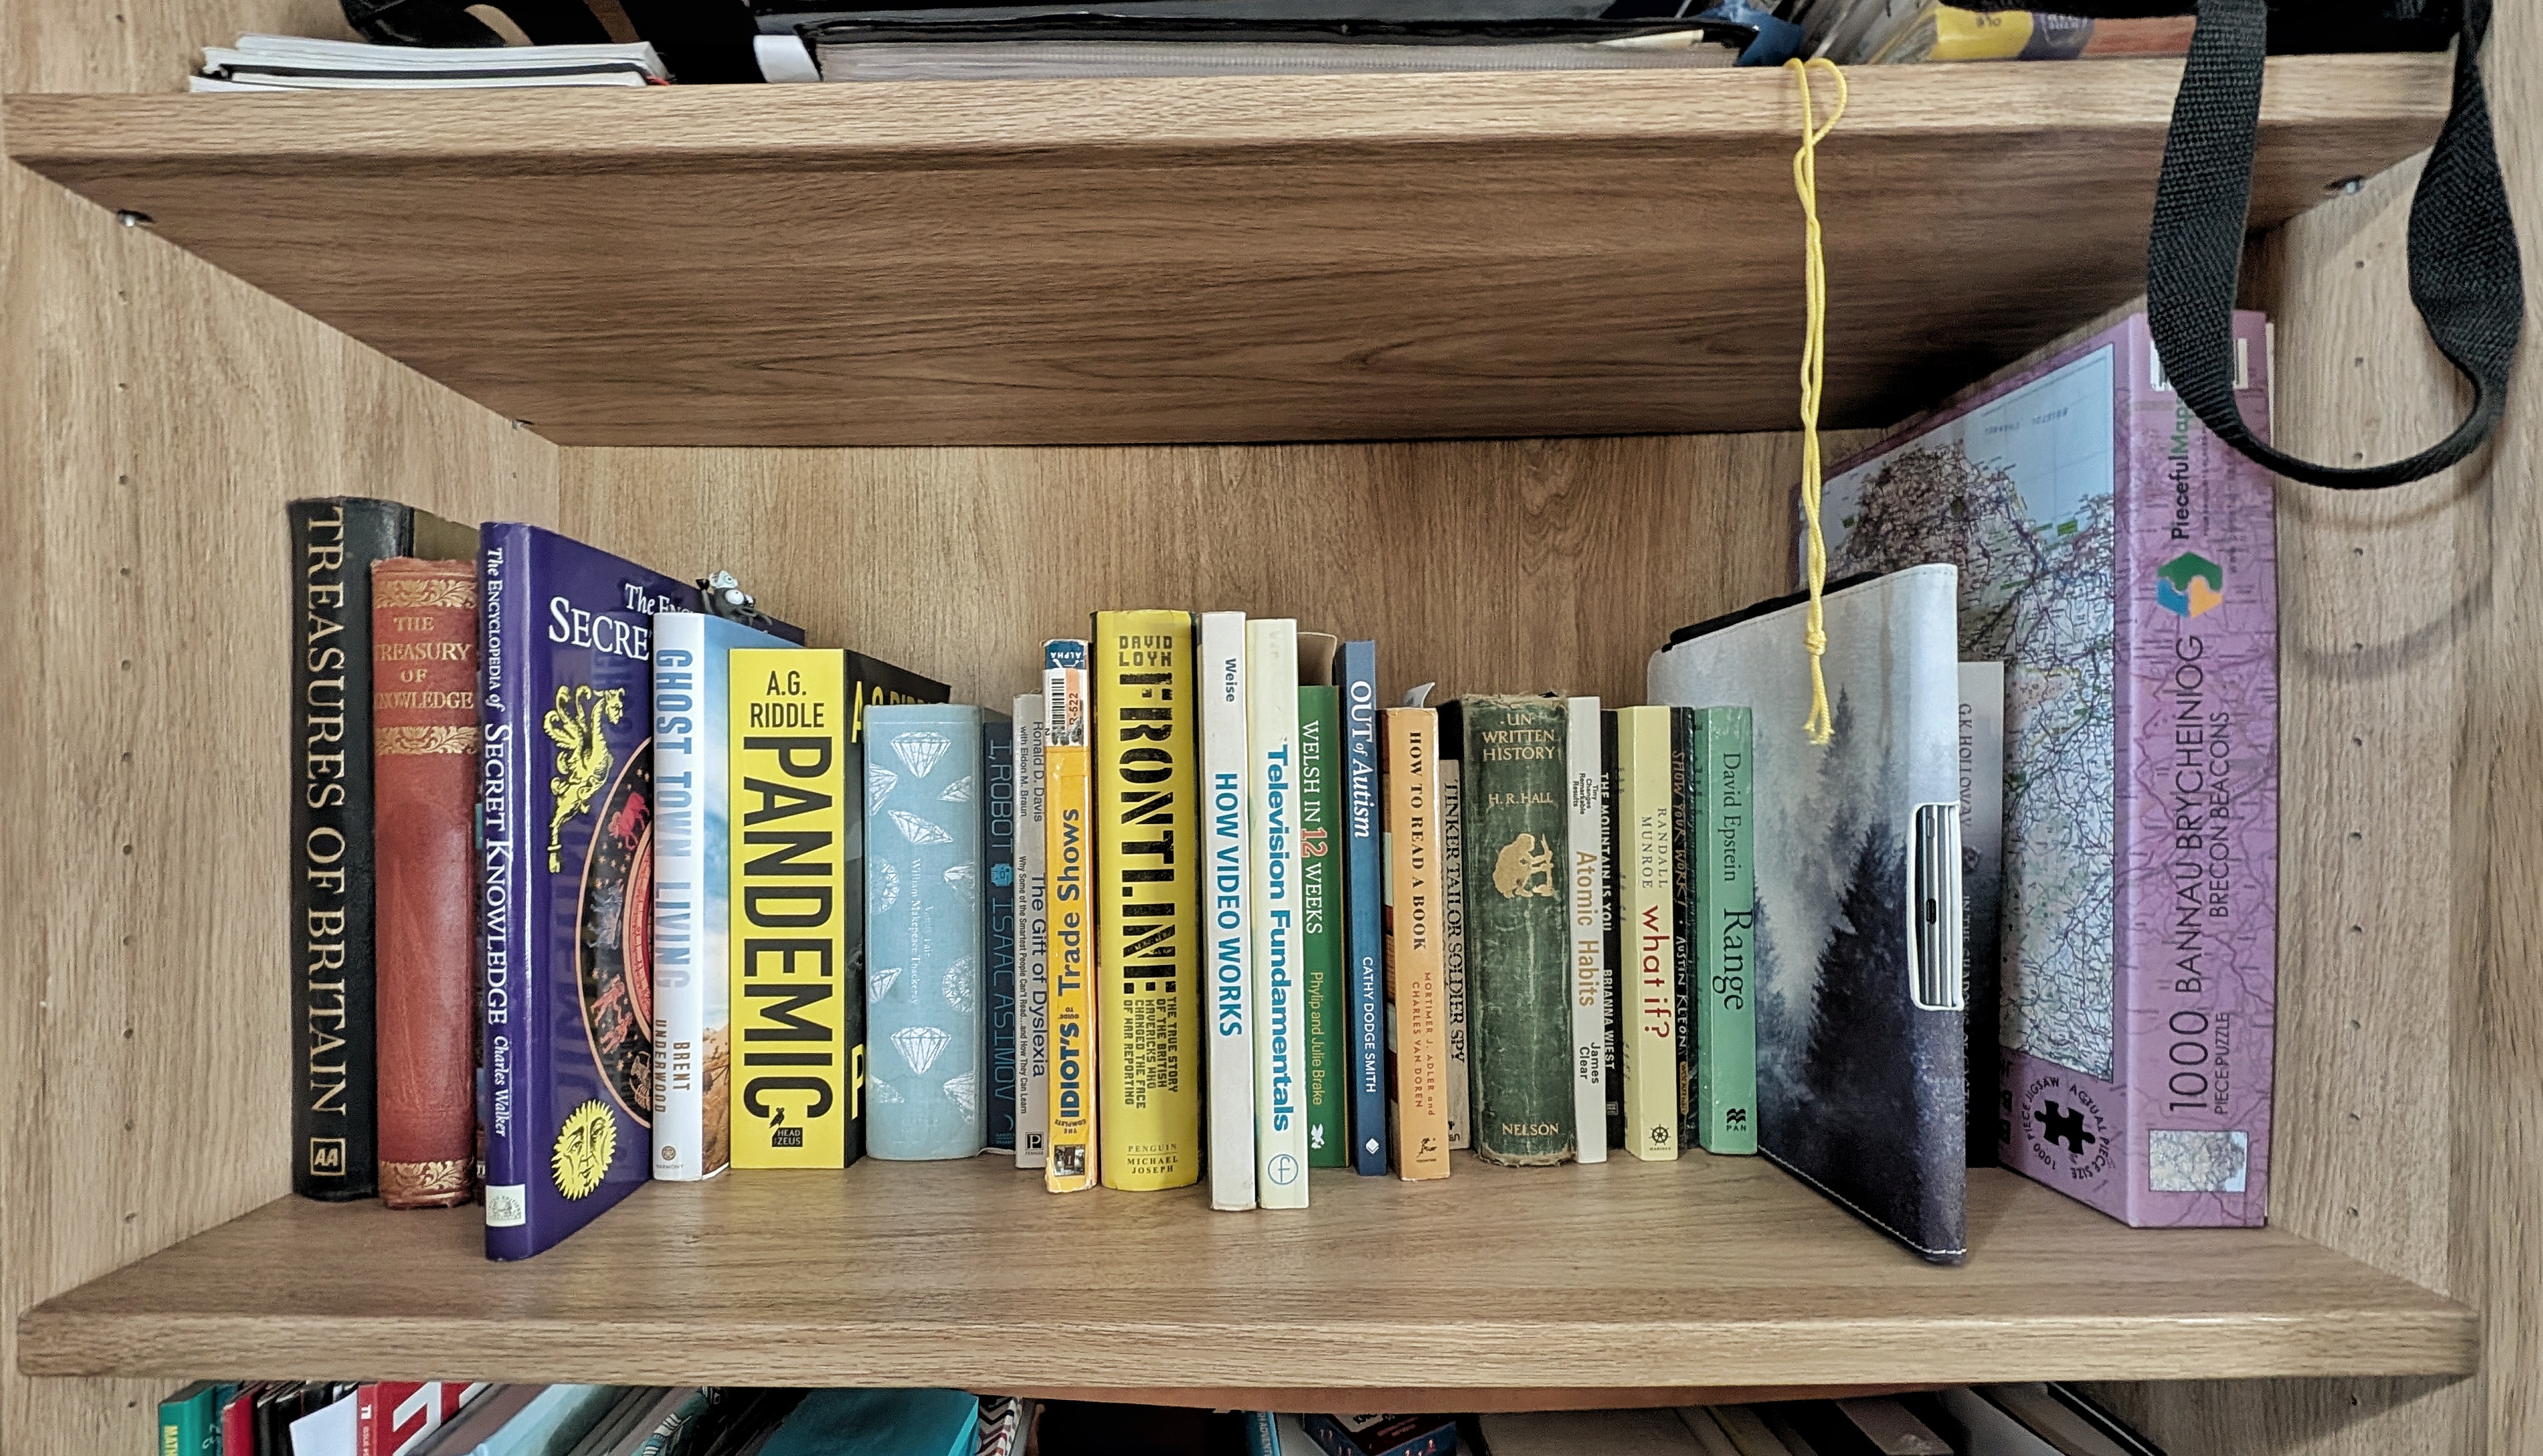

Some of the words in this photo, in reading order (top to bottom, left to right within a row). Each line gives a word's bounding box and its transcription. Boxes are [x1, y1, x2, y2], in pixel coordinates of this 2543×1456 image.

[487, 548, 503, 576] The
[625, 583, 655, 617] The
[392, 616, 434, 632] THE
[487, 580, 503, 690] ENCYCLOPEDIA
[1119, 635, 1172, 649] DAVID
[307, 506, 345, 809] TREASURES
[400, 669, 428, 682] OF
[1050, 651, 1082, 659] ALPHA
[1119, 651, 1172, 667] LOYN
[766, 670, 807, 696] A.G.
[1224, 657, 1237, 703] Weise
[486, 694, 506, 711] of
[655, 649, 693, 754] GHOST
[749, 703, 825, 728] RIDDLE
[1350, 681, 1373, 743] OUT
[1020, 726, 1028, 745] with
[1033, 721, 1044, 765] Ronald
[1352, 742, 1367, 757] of
[1409, 732, 1423, 777] HOW
[1482, 729, 1555, 744] WRITTEN
[1483, 746, 1556, 762] HISTORY
[2175, 634, 2204, 851] BRYCHEINIOG
[484, 724, 512, 831] SECRET
[1020, 747, 1029, 773] Eldon
[1034, 770, 1044, 783] D.
[1303, 720, 1320, 795] WELSH
[1672, 751, 1686, 799] SHOW
[2209, 711, 2229, 820] BEACONS
[1020, 776, 1028, 787] M.
[1353, 758, 1376, 838] Autism
[1410, 783, 1423, 809] TO
[1521, 792, 1553, 804] HALL
[1591, 785, 1599, 801] Tiny
[1601, 772, 1609, 799] THE
[1723, 753, 1742, 808] David
[655, 771, 693, 857] TOWN
[1020, 790, 1029, 817] Braun
[1034, 787, 1045, 822] Davis
[1214, 773, 1239, 839] HOW
[1267, 743, 1291, 900] Television
[1304, 800, 1321, 823] IN
[1445, 779, 1460, 861] TINKER
[1673, 801, 1686, 842] YOUR
[1119, 672, 1176, 994] FRONTLINE
[1301, 827, 1328, 858] 12
[1411, 817, 1424, 870] READ
[1601, 804, 1611, 877] MOUNTAIN
[1641, 816, 1653, 888] MUNROE
[1658, 807, 1668, 888] RANDALL
[1718, 815, 1742, 882] Epstein
[307, 827, 345, 892] OF
[1018, 856, 1026, 871] Why
[1057, 809, 1080, 901] Shows
[2209, 825, 2229, 918] BRECON
[1019, 873, 1027, 893] Some
[1032, 873, 1046, 911] The
[1216, 844, 1240, 930] VIDEO
[1305, 862, 1323, 935] WEEKS
[1412, 877, 1425, 889] A
[1576, 851, 1599, 926] Atomic
[1674, 849, 1688, 907] WORK!
[1447, 862, 1463, 937] TAILOR
[1602, 897, 1613, 931] YOU
[486, 833, 513, 1025] KNOWLEDGE
[653, 881, 691, 988] LIVING
[743, 736, 833, 1118] PANDEMIC
[992, 897, 1014, 986] ISAAC
[1019, 918, 1027, 951] Smartest
[1032, 919, 1047, 956] Gift
[1412, 895, 1426, 951] BOOK
[2175, 862, 2203, 994] BANNAU
[1018, 953, 1027, 977] People
[1058, 912, 1081, 997] Trade
[1642, 905, 1670, 988] what
[1676, 936, 1687, 986] AUSTIN
[1712, 908, 1754, 1011] Range
[1019, 978, 1028, 998] Can't
[1032, 964, 1047, 983] of
[1218, 936, 1242, 1038] WORKS
[1309, 972, 1324, 1009] Phylip
[1362, 956, 1373, 1000] CATHY
[1447, 941, 1464, 1025] SOLDIER
[1577, 940, 1599, 1007] Habits
[308, 907, 346, 1116] BRITAIN
[1124, 1000, 1134, 1016] OF
[1156, 999, 1166, 1014] OF
[1166, 997, 1177, 1018] THE
[1412, 982, 1421, 1035] CHARLES
[1425, 972, 1433, 1035] MORTIMER
[1603, 969, 1613, 1026] BRIANNA
[1644, 998, 1672, 1038] if?
[1029, 990, 1048, 1077] Dyslexia
[1124, 1018, 1134, 1040] WAR
[1135, 1000, 1146, 1050] CHANGED
[1145, 1000, 1156, 1063] MAVERICKS
[1157, 1018, 1167, 1041] THE
[1166, 1020, 1178, 1051] TRUE
[1270, 909, 1295, 1132] Fundamentals
[1310, 1012, 1324, 1034] and
[1363, 1003, 1375, 1050] DODGE
[1676, 994, 1688, 1048] KLEON
[2215, 1012, 2231, 1066] PUZZLE
[493, 1036, 509, 1086] Charles
[655, 1019, 667, 1113] UNDERWOOD
[673, 1042, 691, 1091] BRENT
[994, 993, 1016, 1100] ASIMOV
[1136, 1053, 1146, 1074] THE
[1157, 1043, 1168, 1088] BRITISH
[1311, 1036, 1325, 1068] Julie
[1413, 1039, 1422, 1062] VAN
[1451, 1029, 1465, 1064] SPY
[1579, 1046, 1590, 1080] Clear
[1590, 1042, 1599, 1085] James
[1605, 1029, 1615, 1069] WIEST
[2168, 1010, 2209, 1112] 1000
[1060, 1022, 1080, 1118] IDIOT'S
[1124, 1043, 1134, 1105] REPORTING
[1146, 1065, 1157, 1089] WHO
[1168, 1054, 1178, 1093] STORY
[1311, 1069, 1325, 1106] Brake
[1364, 1052, 1376, 1093] SMITH
[1414, 1068, 1423, 1108] DOREN
[1426, 1054, 1435, 1090] ADLER
[2024, 1076, 2060, 1105] JIGSAW
[1020, 1094, 1028, 1114] Learn
[1136, 1076, 1146, 1109] FACE
[2213, 1068, 2231, 1116] PIECE
[494, 1089, 510, 1137] Walker
[777, 1129, 801, 1137] HEAD
[1502, 1123, 1559, 1136] NELSON
[2022, 1101, 2033, 1140] PIECE
[314, 1146, 339, 1166] AA
[777, 1137, 801, 1145] ZEUS
[1127, 1156, 1178, 1166] MICHAEL
[1128, 1143, 1178, 1153] PENGUIN
[2033, 1142, 2057, 1171] 1000
[2091, 1135, 2111, 1173] PIECE
[1131, 1165, 1174, 1174] JOSEPH
[2071, 1158, 2095, 1180] SIZE
